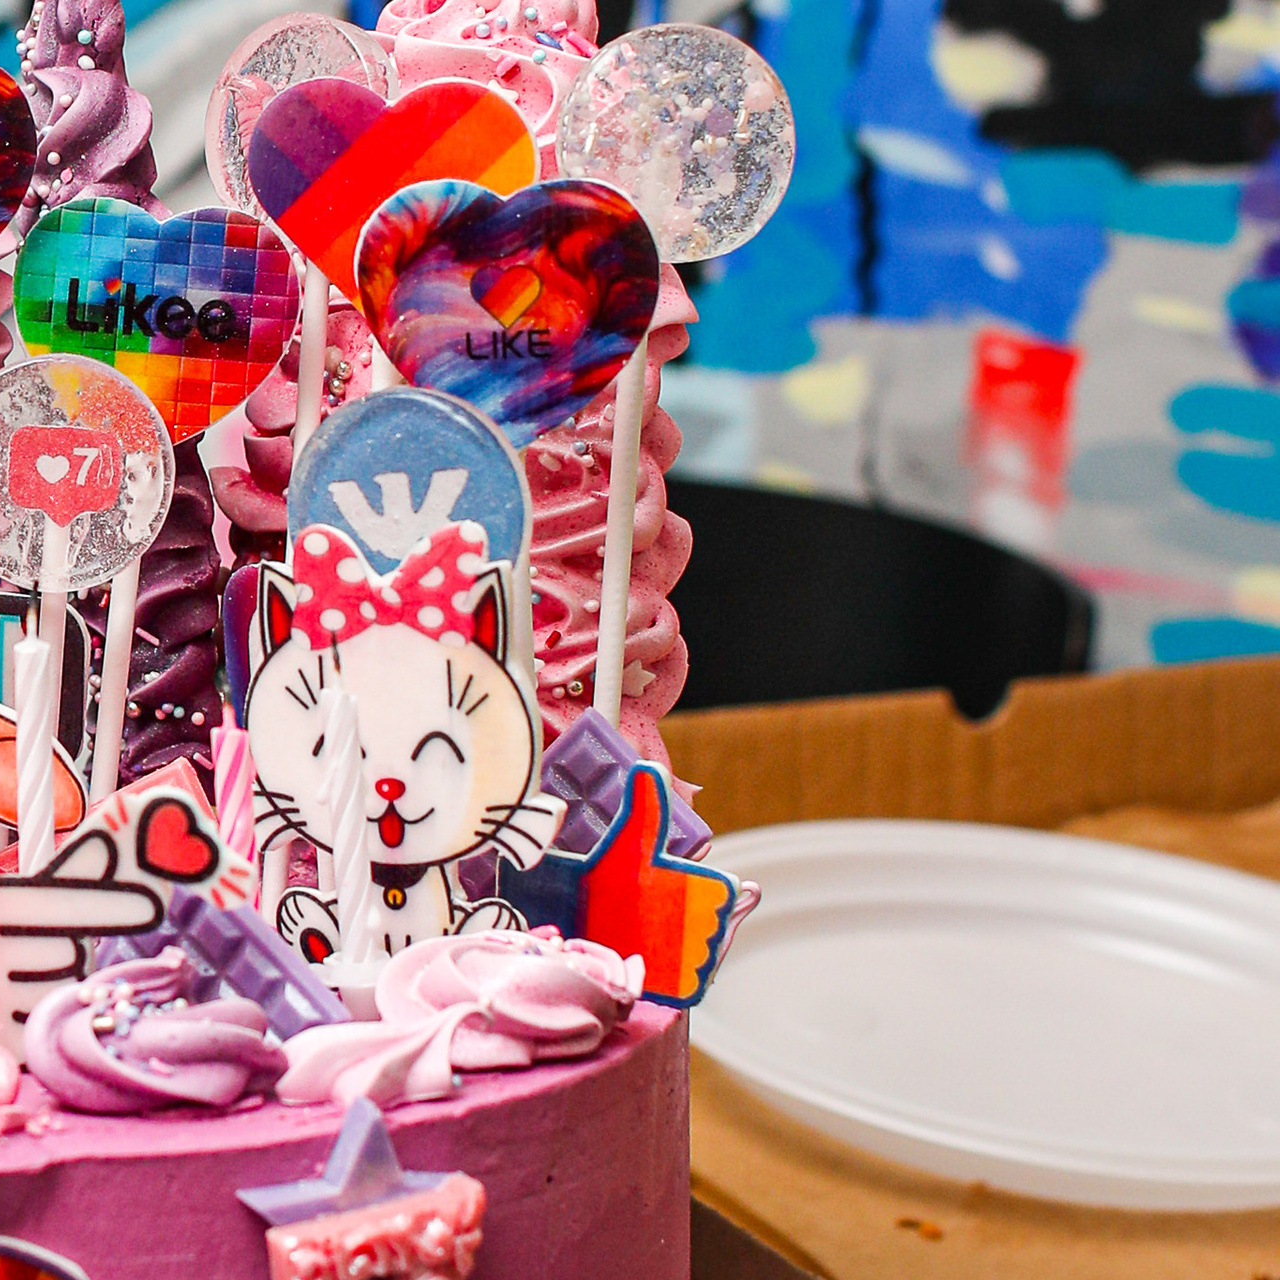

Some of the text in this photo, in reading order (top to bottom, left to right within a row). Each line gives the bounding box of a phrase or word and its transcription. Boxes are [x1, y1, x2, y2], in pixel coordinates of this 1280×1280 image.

[66, 276, 237, 344] Likee
[465, 329, 552, 361] LIKE
[72, 446, 100, 487] 7
